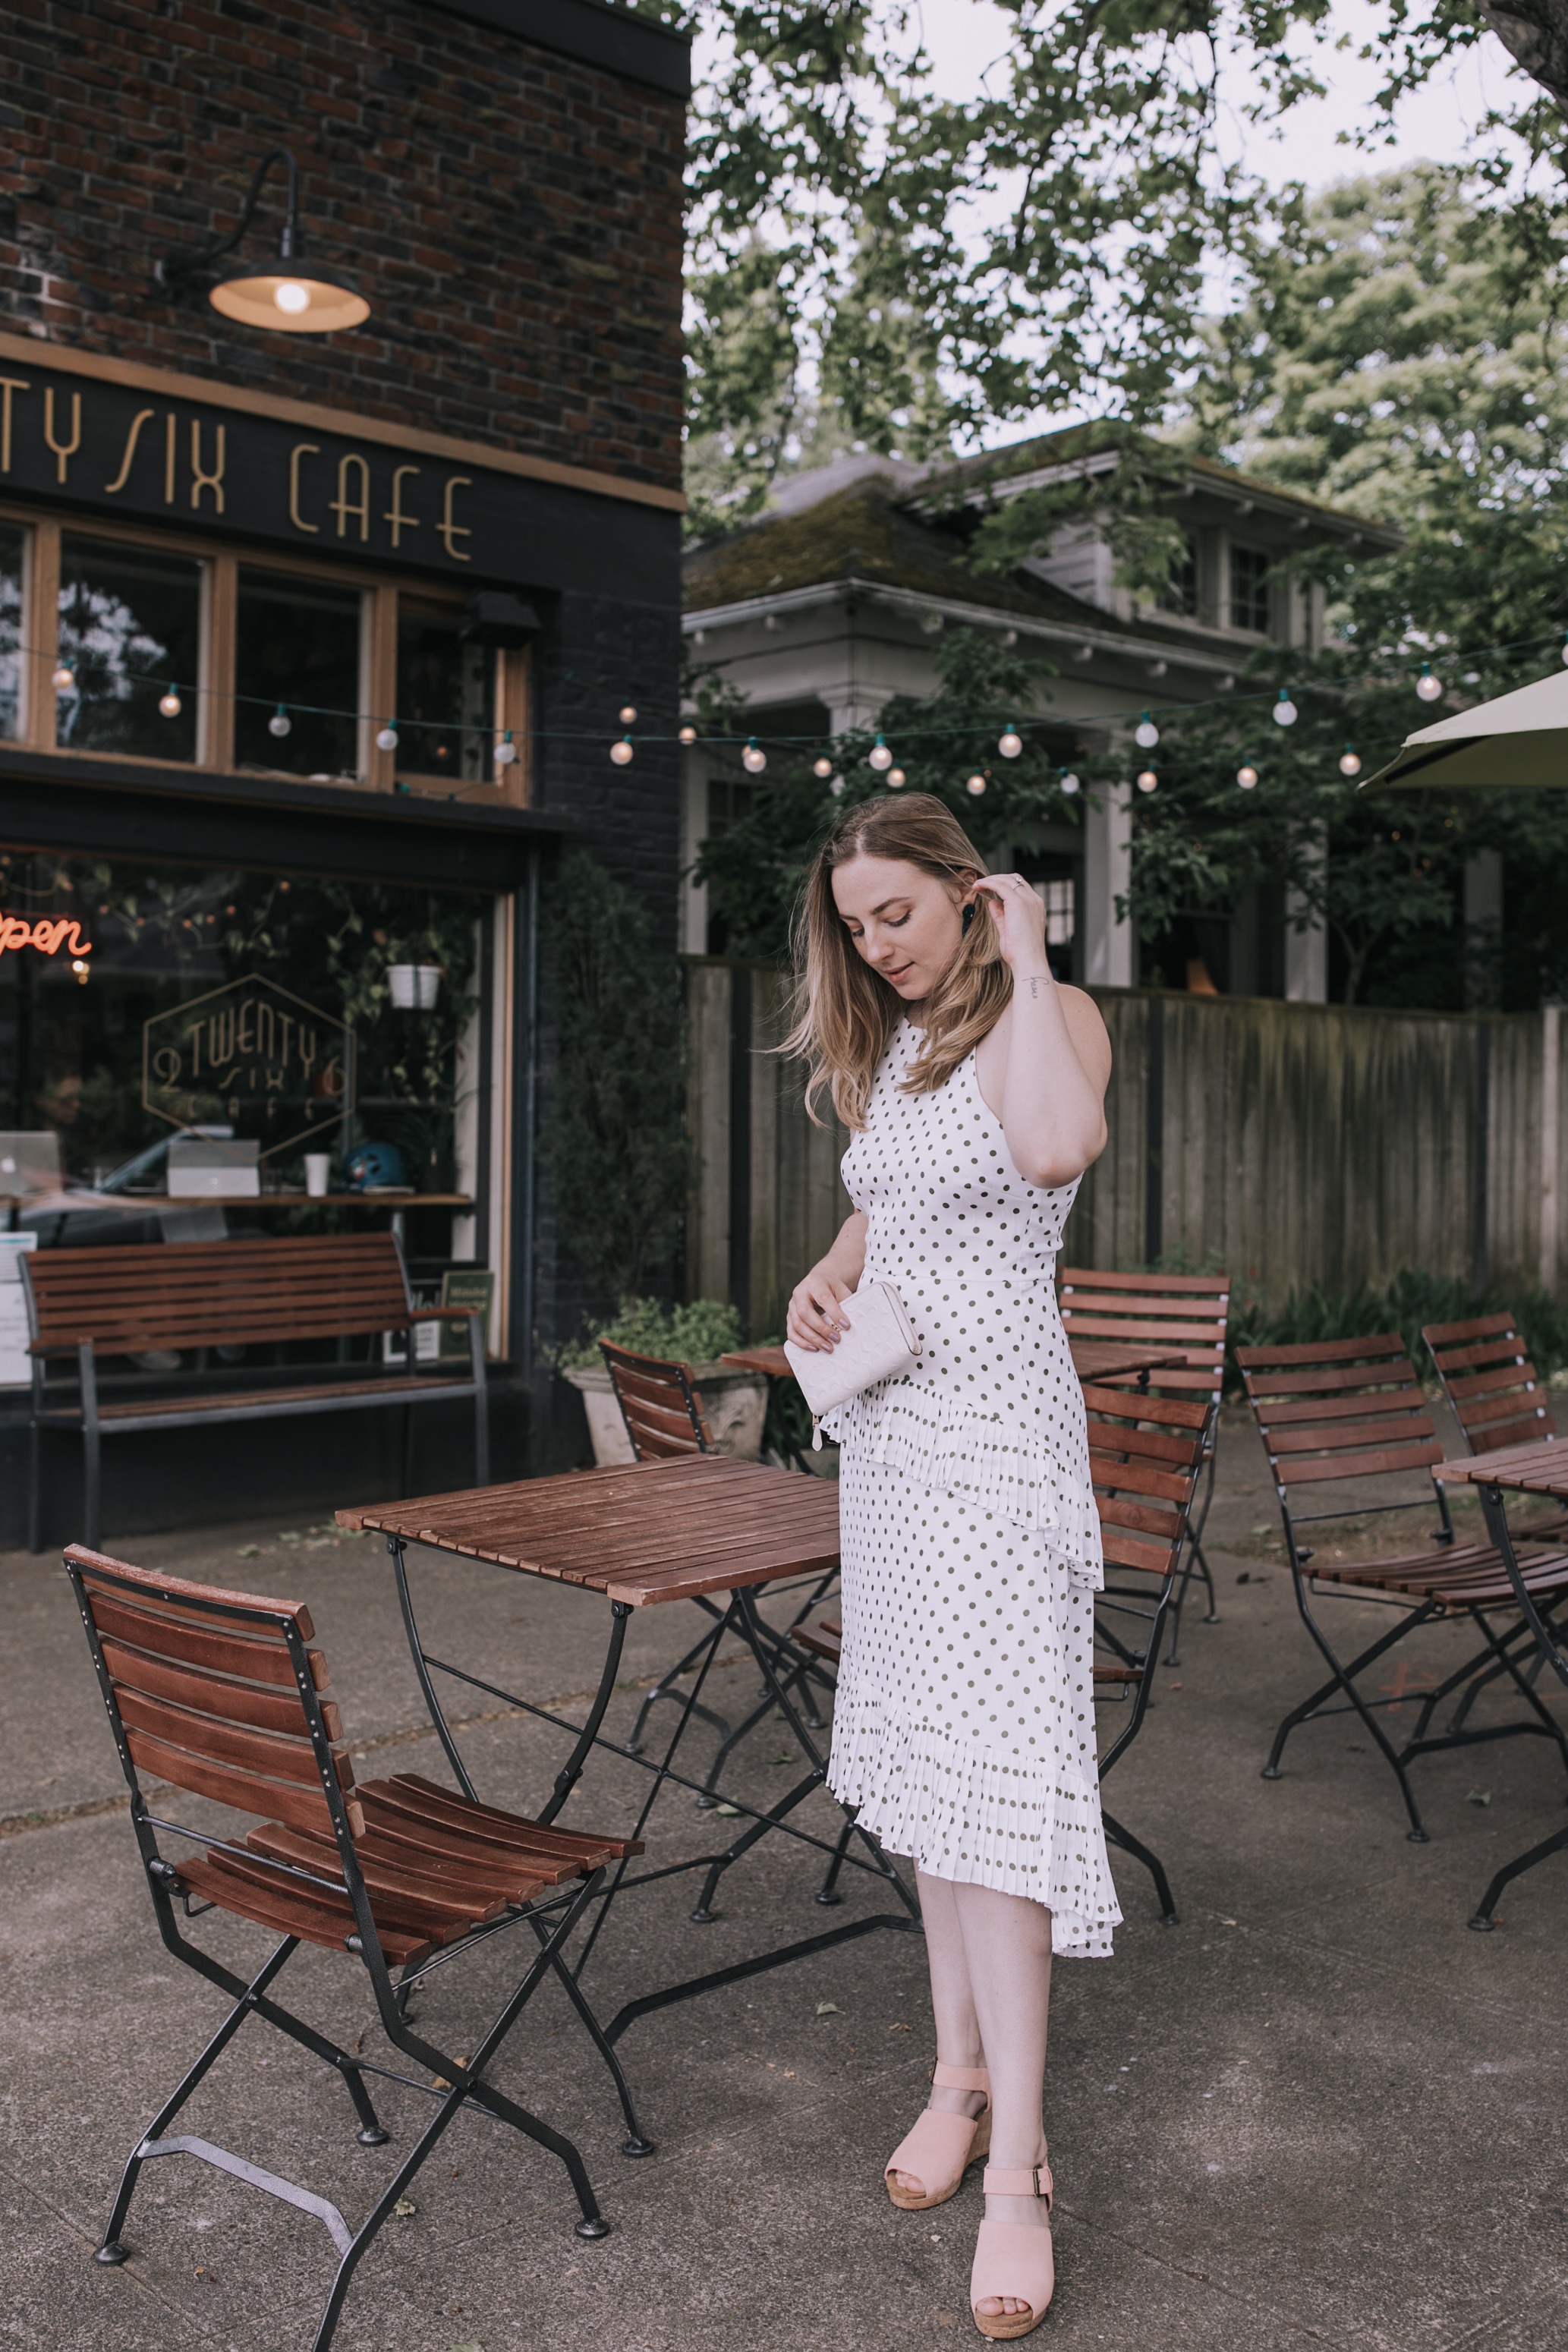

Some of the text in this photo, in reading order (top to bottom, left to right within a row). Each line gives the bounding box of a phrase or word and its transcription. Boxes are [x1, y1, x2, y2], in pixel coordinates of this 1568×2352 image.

[104, 408, 225, 515] SIX
[289, 443, 473, 561] CAFE
[0, 912, 92, 956] pen
[187, 998, 316, 1081] TWENTY
[153, 1047, 181, 1092] 2
[218, 1066, 284, 1091] SIX
[322, 1056, 348, 1096] 6
[187, 1096, 313, 1121] CAFE
